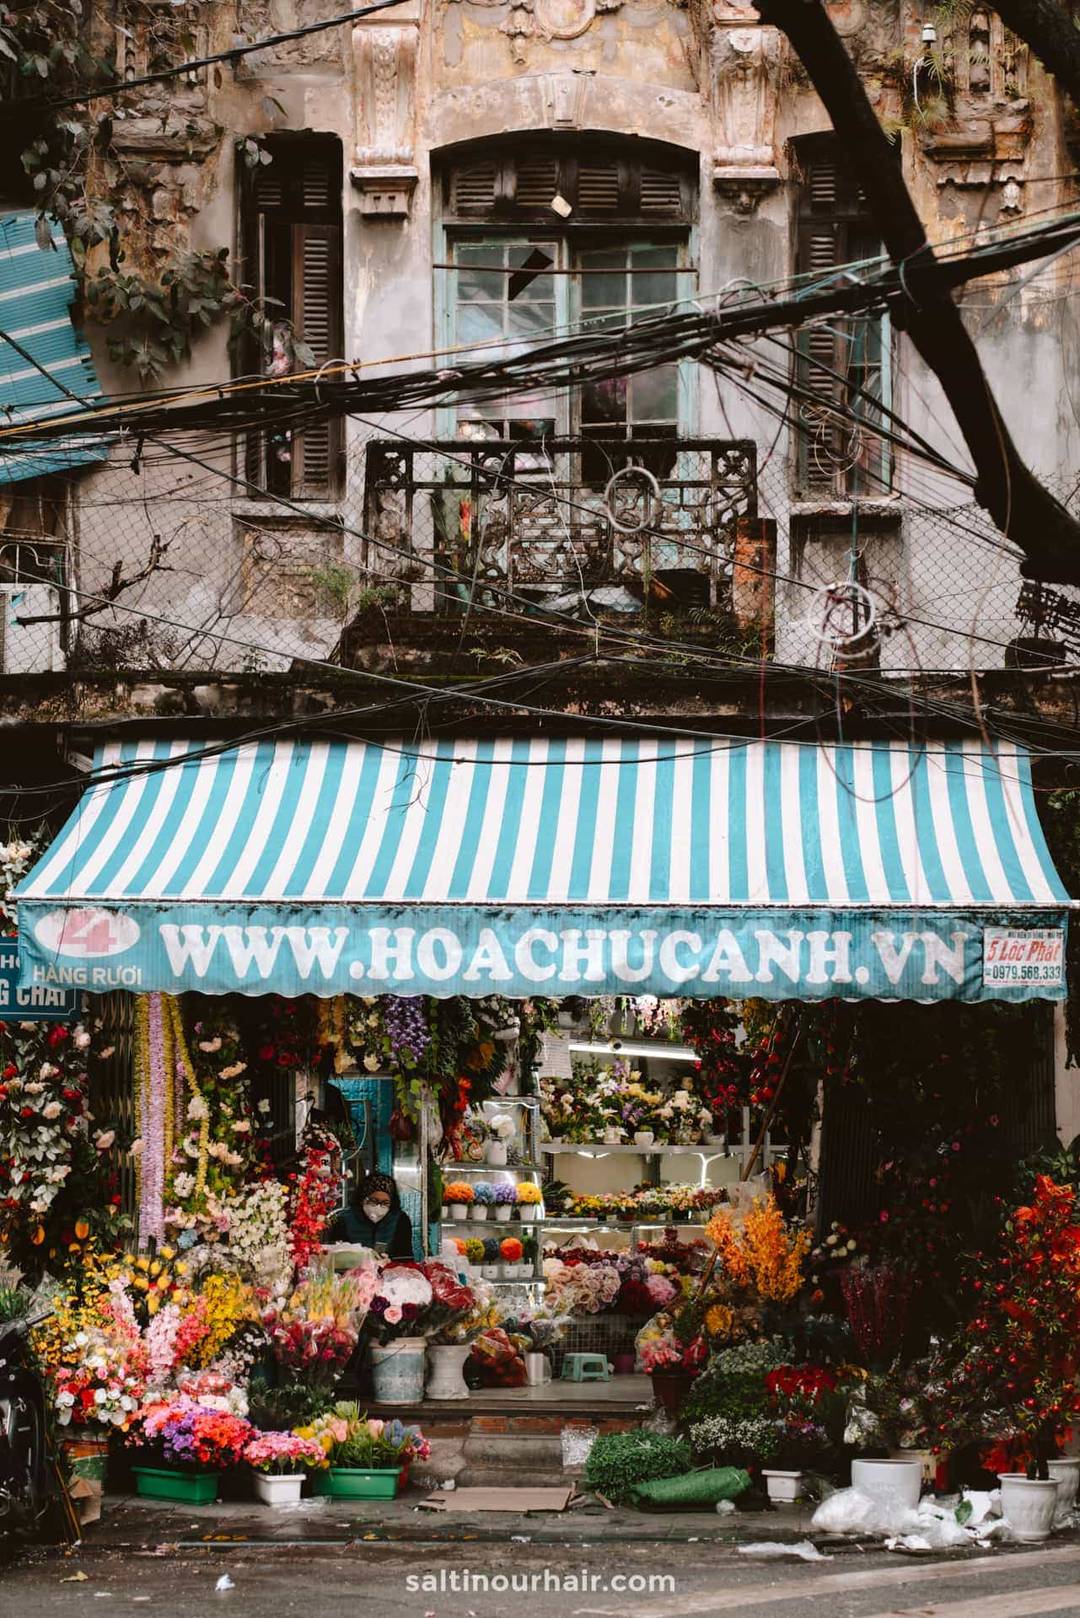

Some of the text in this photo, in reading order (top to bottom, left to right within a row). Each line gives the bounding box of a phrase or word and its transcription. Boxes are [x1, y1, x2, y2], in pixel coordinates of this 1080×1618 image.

[57, 910, 117, 952] 4
[159, 924, 969, 985] WWW.HOACHUCANH.VN
[987, 940, 999, 961] 5
[33, 962, 88, 985] HÀNG
[992, 965, 1061, 979] 0979.568.333
